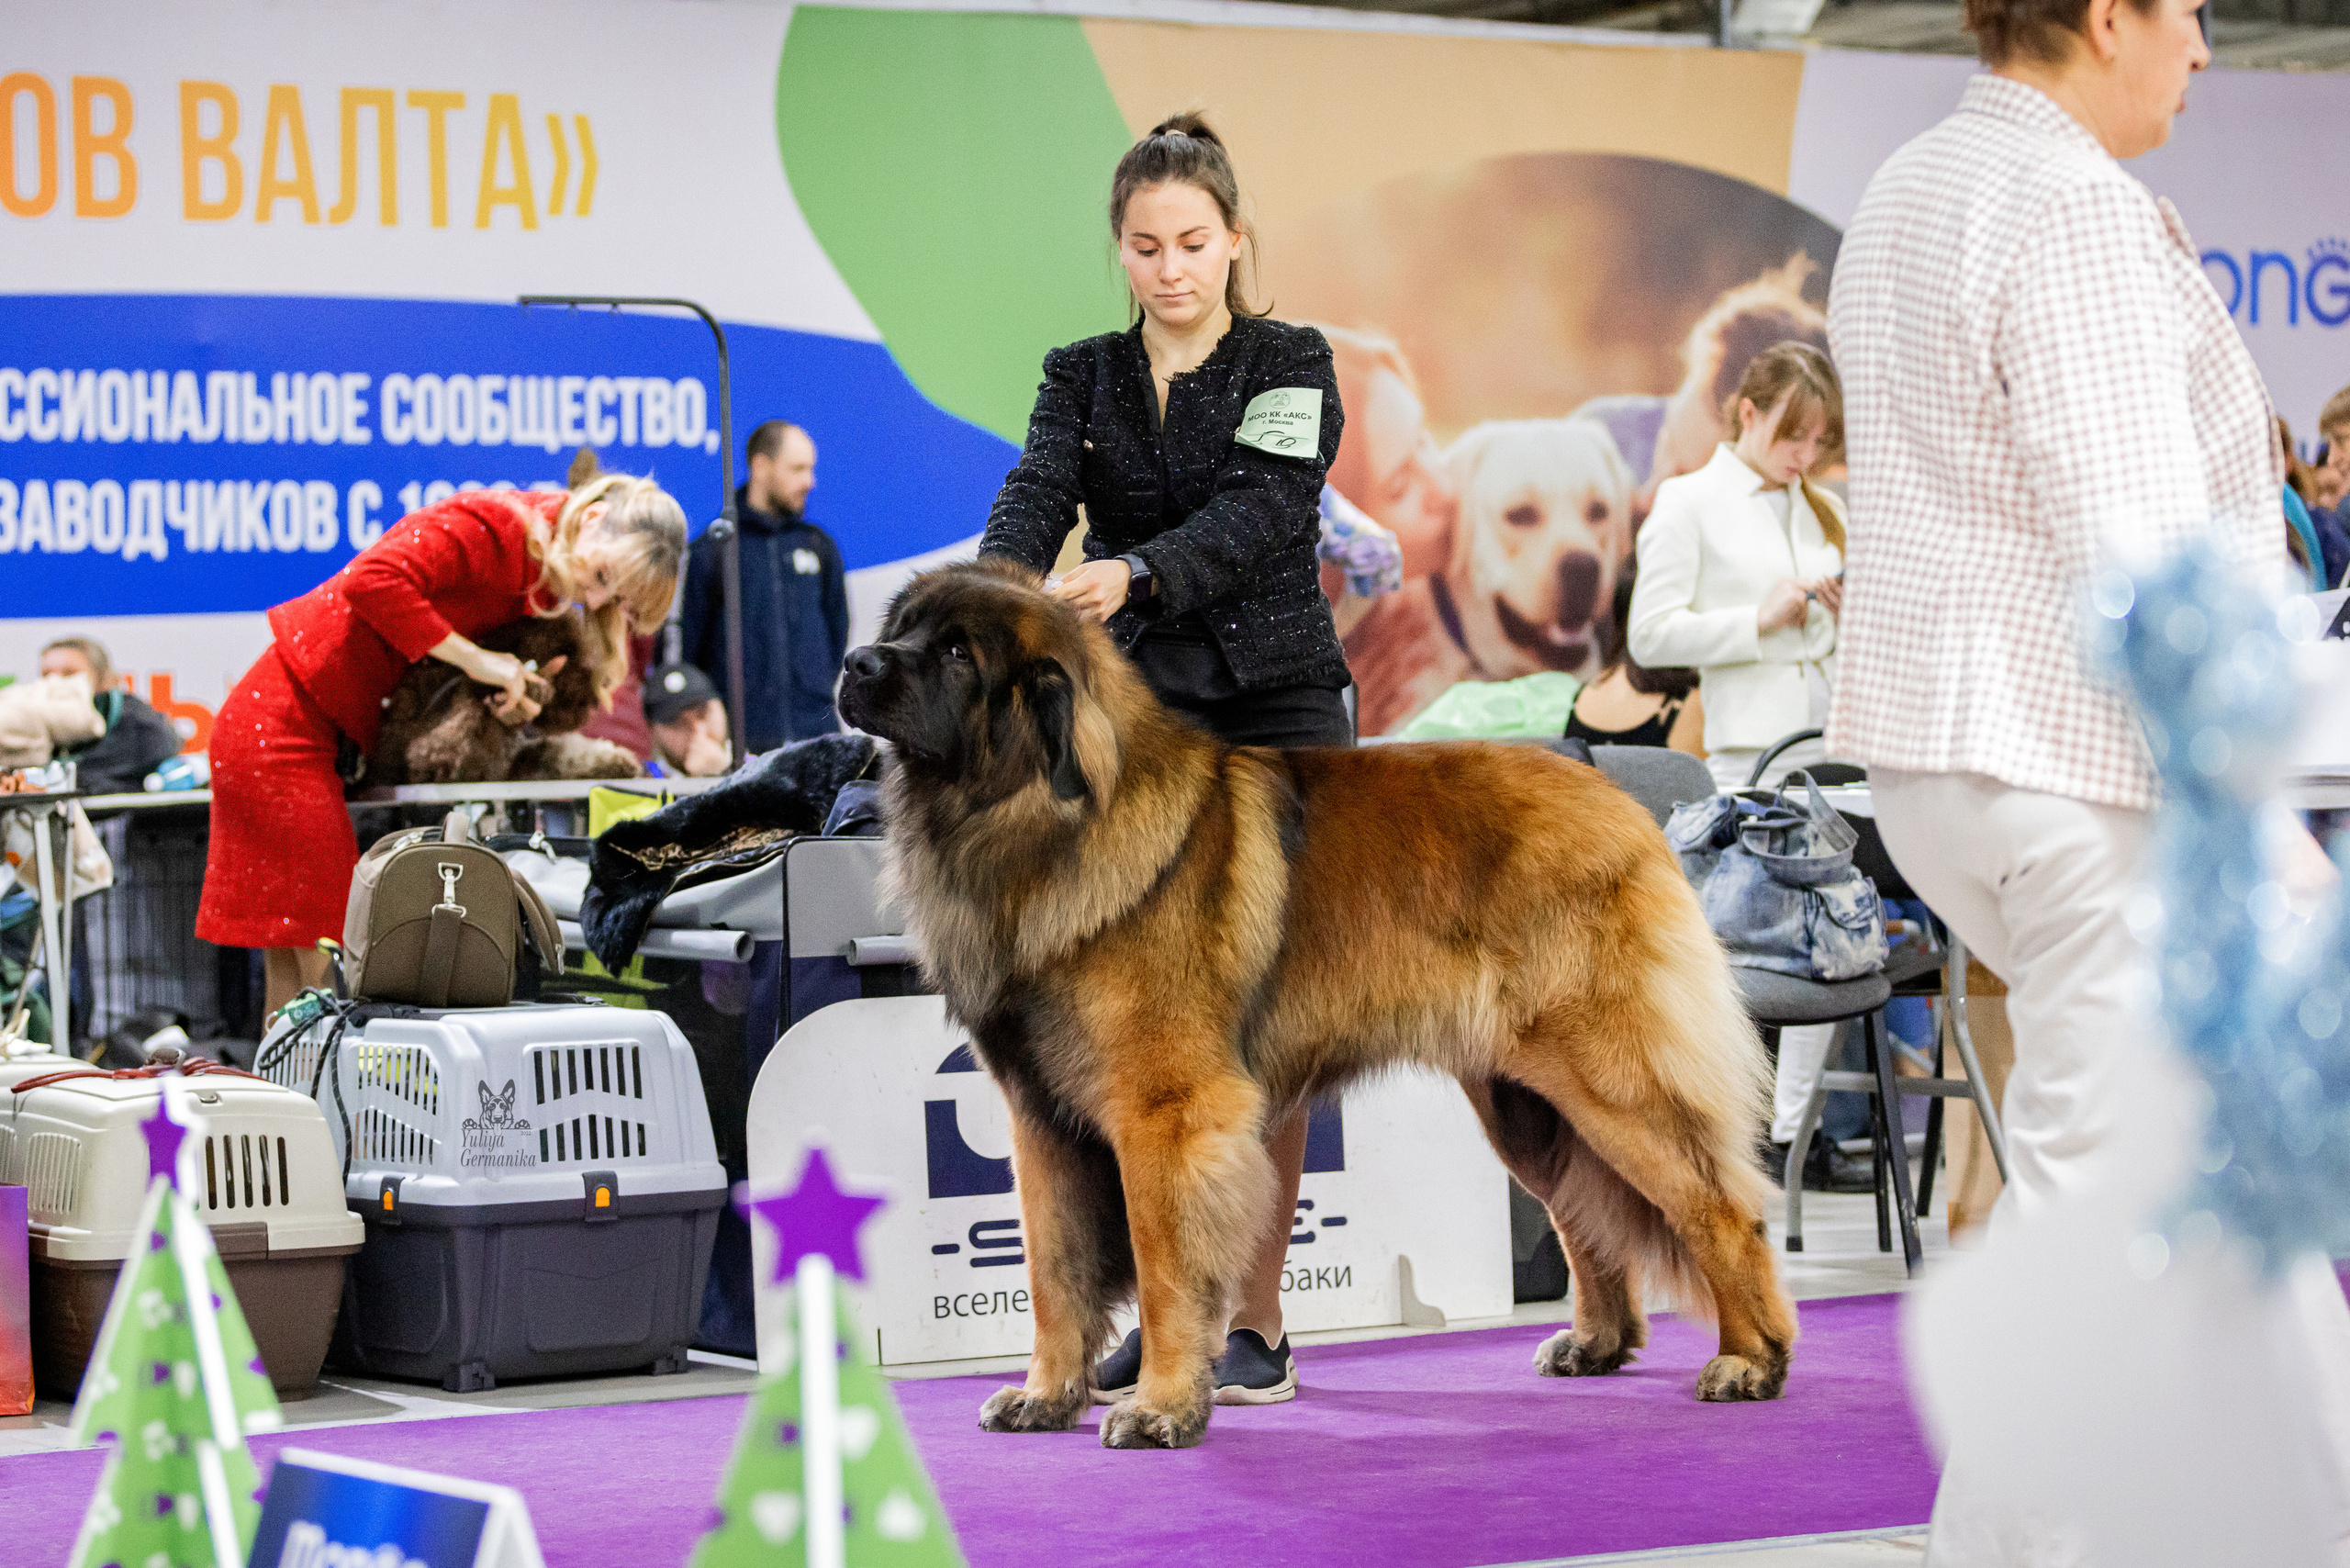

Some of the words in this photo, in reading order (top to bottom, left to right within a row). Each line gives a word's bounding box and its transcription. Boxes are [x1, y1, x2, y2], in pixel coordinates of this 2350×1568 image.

[179, 79, 599, 230] ВАЛТА»
[380, 372, 720, 454] СООБЩЕСТВО,
[1283, 411, 1312, 420] «АКС»
[462, 1129, 505, 1152] Yuliya
[460, 1148, 536, 1167] Germanika
[934, 1289, 1029, 1319] вселе
